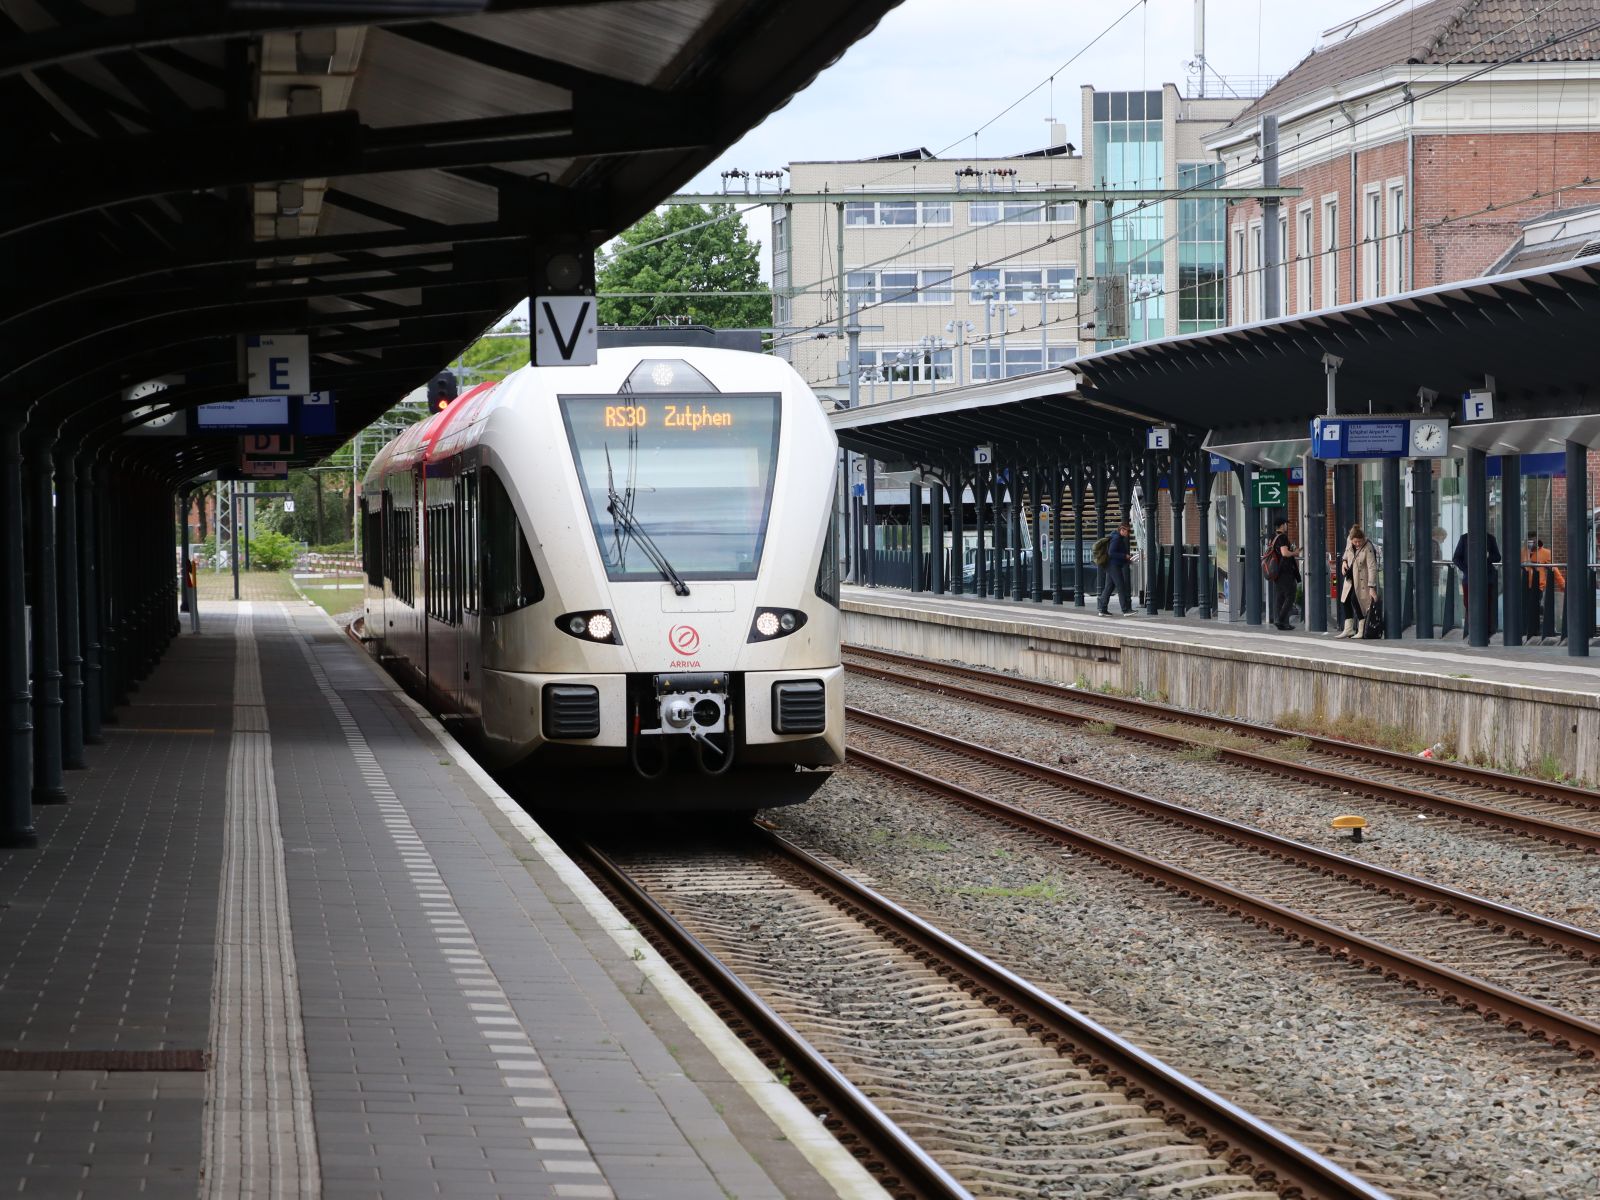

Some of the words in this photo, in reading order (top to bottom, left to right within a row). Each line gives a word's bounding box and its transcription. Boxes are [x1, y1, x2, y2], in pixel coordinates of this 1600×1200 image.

[541, 301, 591, 361] V
[269, 357, 290, 390] E
[311, 391, 321, 403] 3
[1476, 402, 1484, 417] F
[605, 406, 646, 427] RS30
[664, 405, 732, 430] Zutphen
[255, 433, 270, 450] D
[1156, 436, 1163, 447] E
[979, 453, 988, 463] D
[856, 463, 863, 472] C
[286, 502, 292, 510] V
[670, 660, 701, 668] ARRIVA
